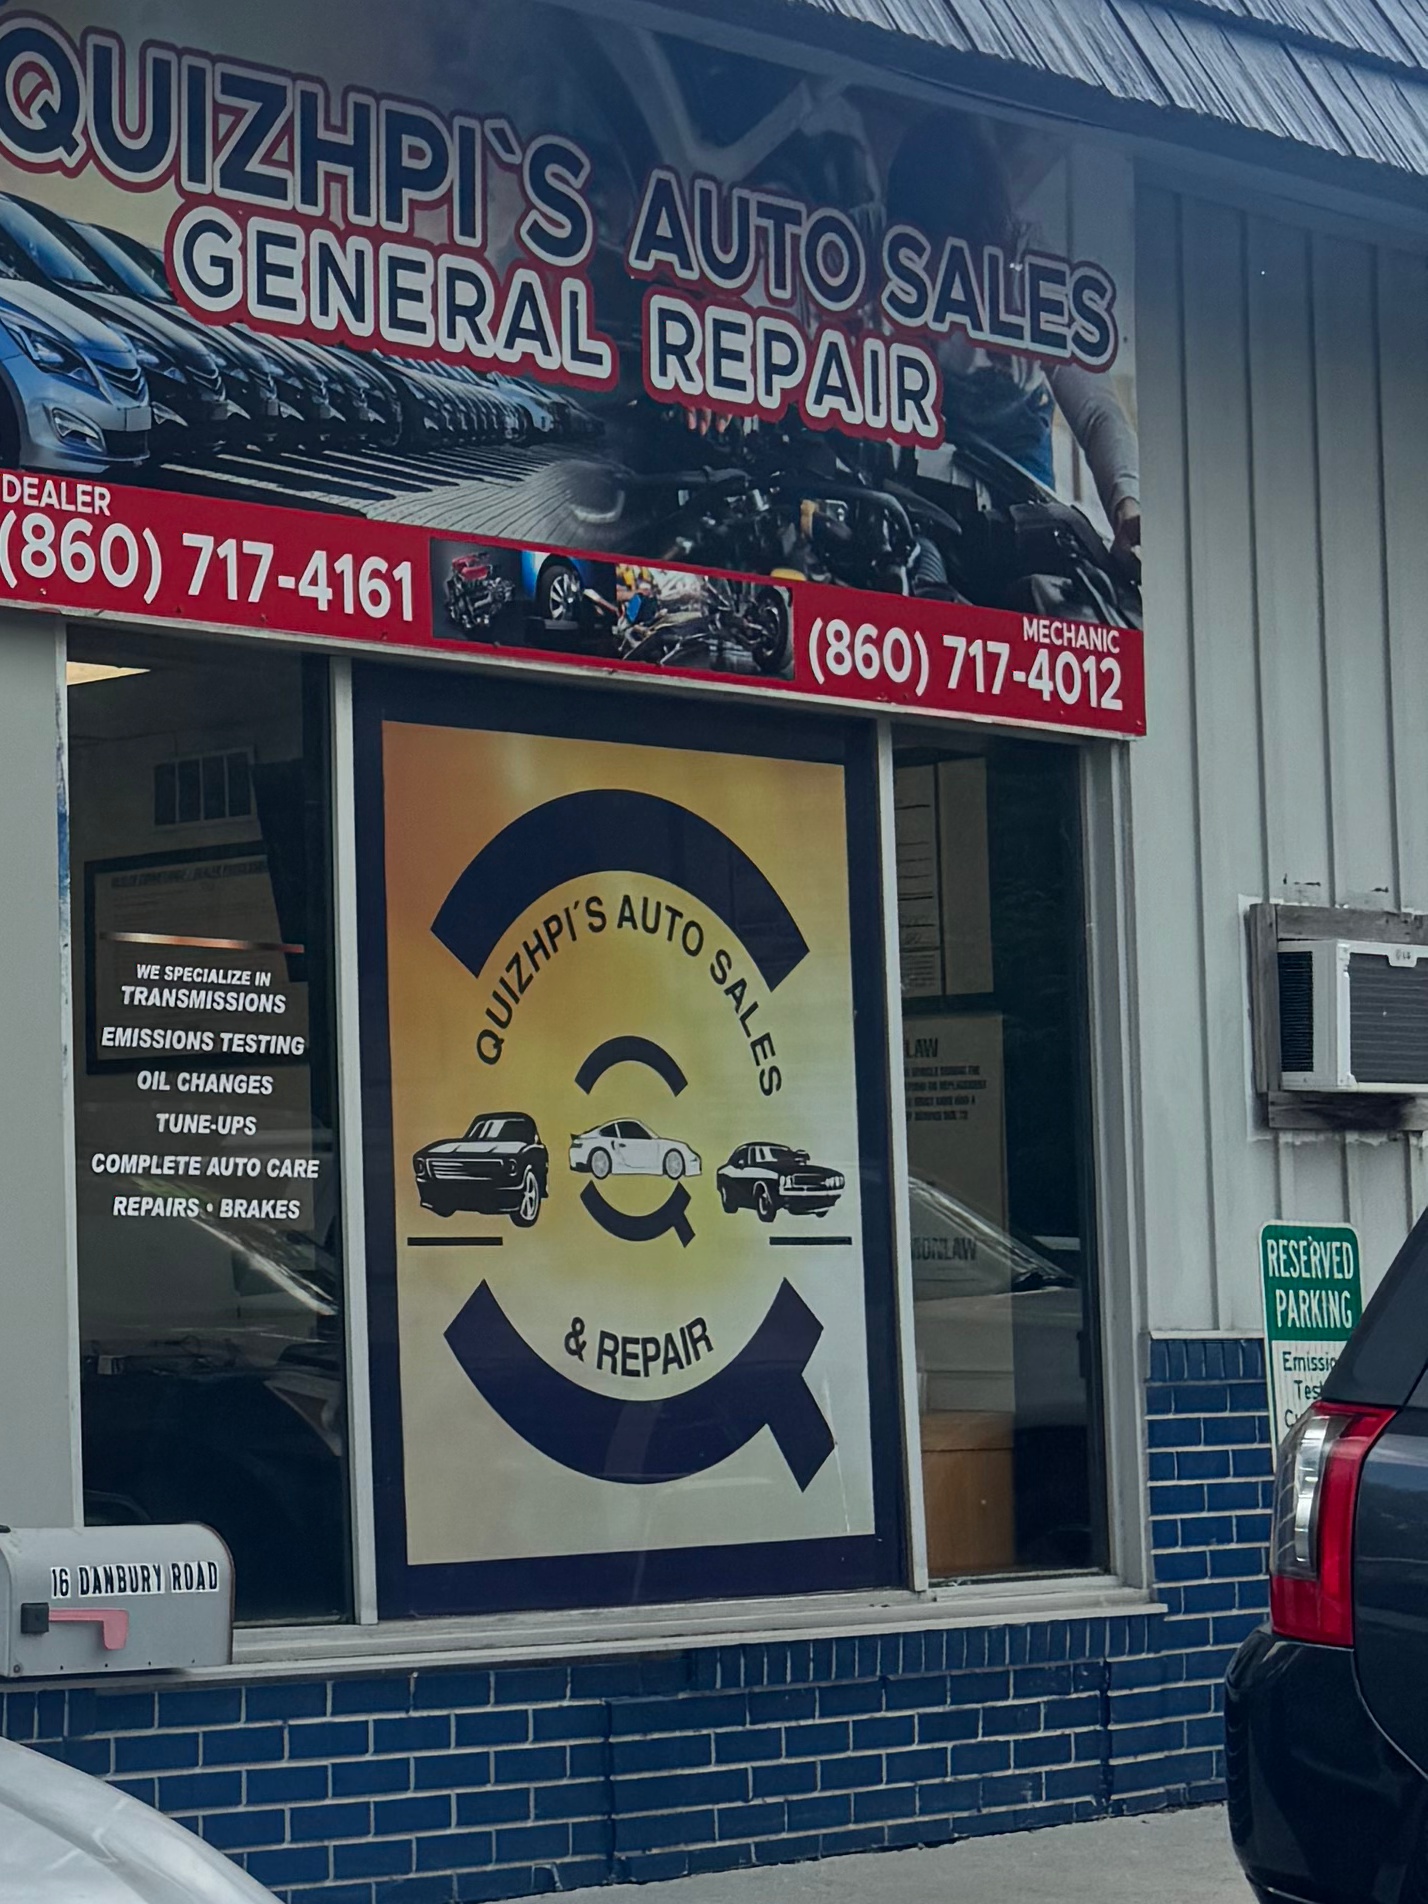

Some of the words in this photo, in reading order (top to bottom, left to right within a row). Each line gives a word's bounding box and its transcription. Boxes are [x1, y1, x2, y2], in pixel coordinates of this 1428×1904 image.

[629, 168, 864, 313] AUTO
[882, 220, 1120, 373] SALES
[172, 204, 615, 381] GENERAL
[649, 297, 940, 442] REPAIR
[3, 473, 110, 516] DEALER
[184, 534, 416, 624] 717-4161
[1023, 617, 1121, 653] MECHANIC
[808, 616, 931, 698] (860)
[943, 636, 1124, 710] 717-4012
[137, 964, 160, 979] WE
[164, 966, 251, 985] SPECIALIZE
[255, 972, 271, 987] IN
[121, 986, 286, 1013] TRANSMISSIONS
[616, 895, 705, 962] AUTO
[708, 949, 783, 1097] SALES
[101, 1027, 214, 1051] EMISSIONS
[220, 1032, 305, 1055] TESTING
[137, 1071, 170, 1092] OIL
[176, 1072, 274, 1095] CHANGES
[155, 1113, 257, 1136] TUNE-UPS
[91, 1153, 203, 1177] COMPLETE
[207, 1156, 262, 1178] AUTO
[266, 1157, 320, 1178] CARE
[112, 1197, 200, 1218] REPAIRS
[219, 1199, 300, 1220] BRAKES
[1266, 1239, 1354, 1280] RESERVED
[1275, 1289, 1353, 1329] PARKING
[565, 1316, 587, 1362] &
[595, 1315, 714, 1378] REPAIR
[52, 1567, 70, 1597] 16
[79, 1563, 163, 1594] DANBURY
[171, 1560, 219, 1590] ROAD
